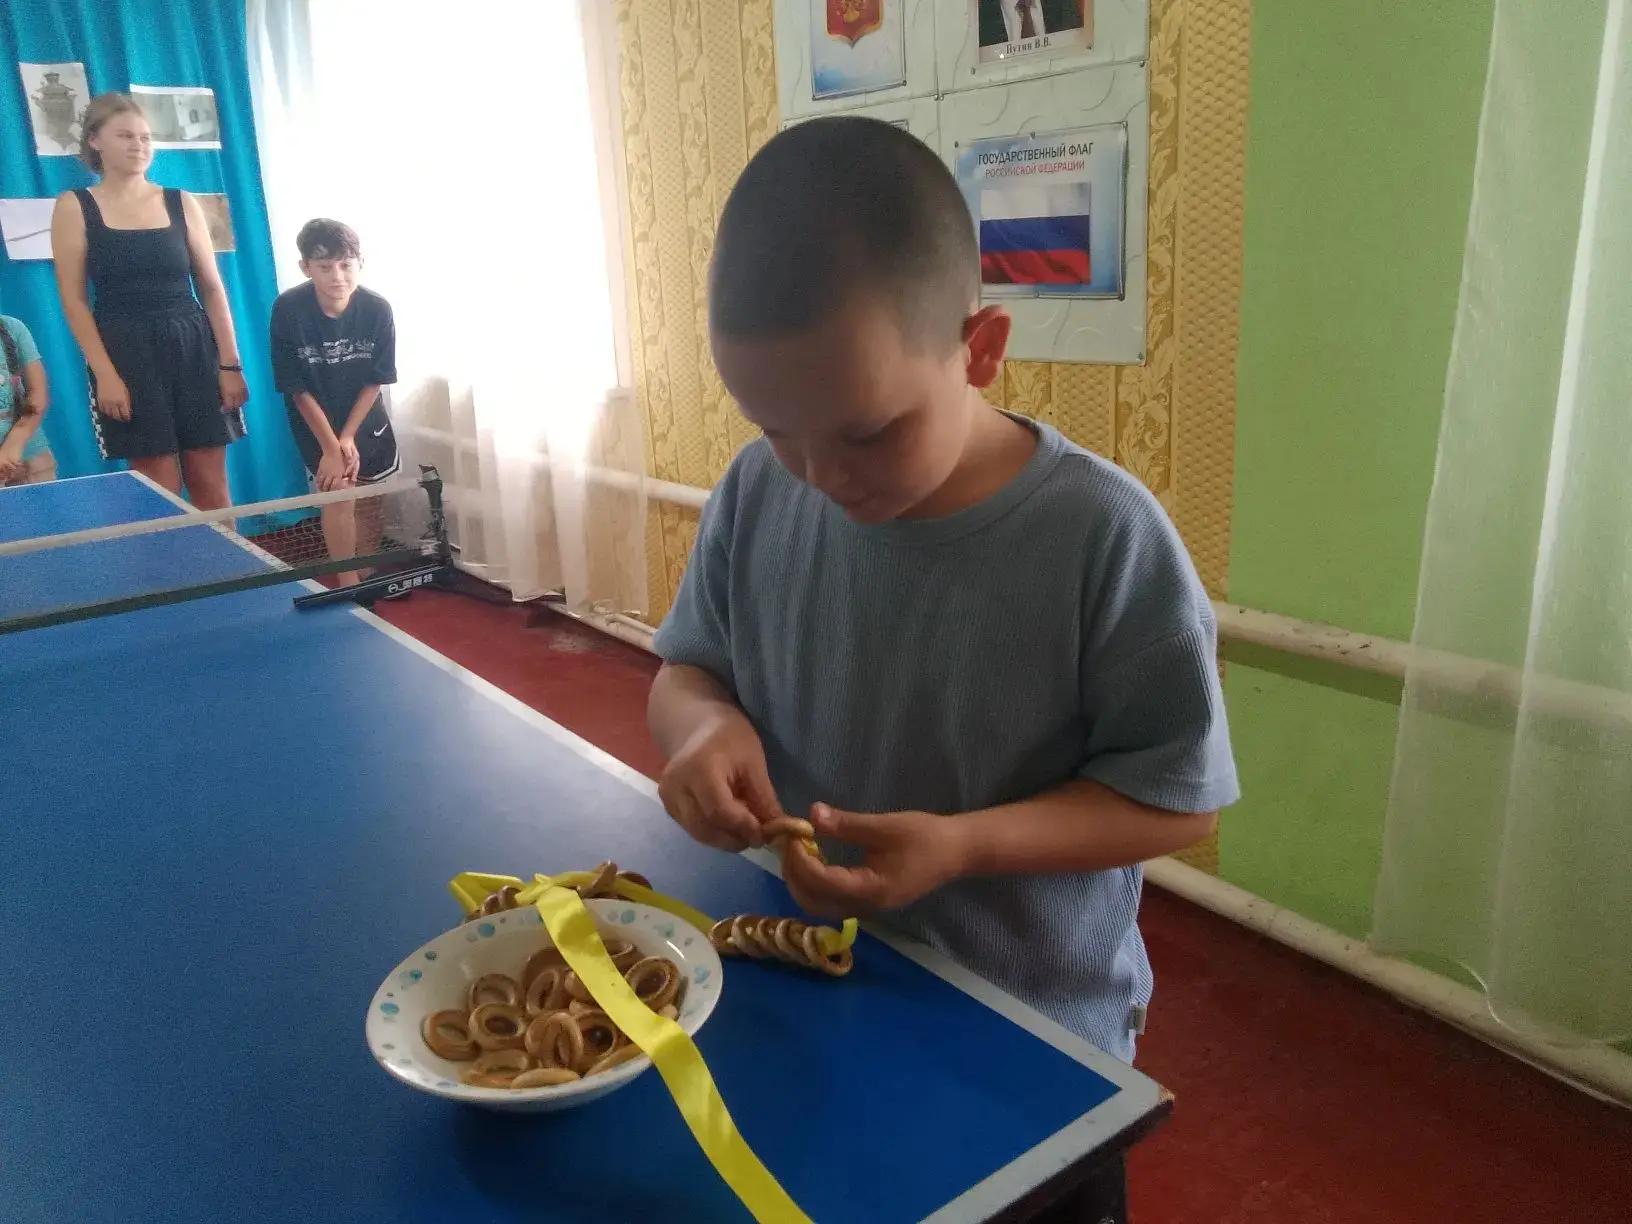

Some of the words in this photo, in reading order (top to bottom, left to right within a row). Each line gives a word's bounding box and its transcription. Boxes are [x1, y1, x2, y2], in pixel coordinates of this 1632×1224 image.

[1006, 42, 1032, 55] Путин
[978, 143, 1066, 165] ГОСУДАРСТВЕННЫЙ
[1068, 142, 1094, 156] ФЛАГ
[1036, 160, 1085, 174] ФЕДЕРАЦИИ
